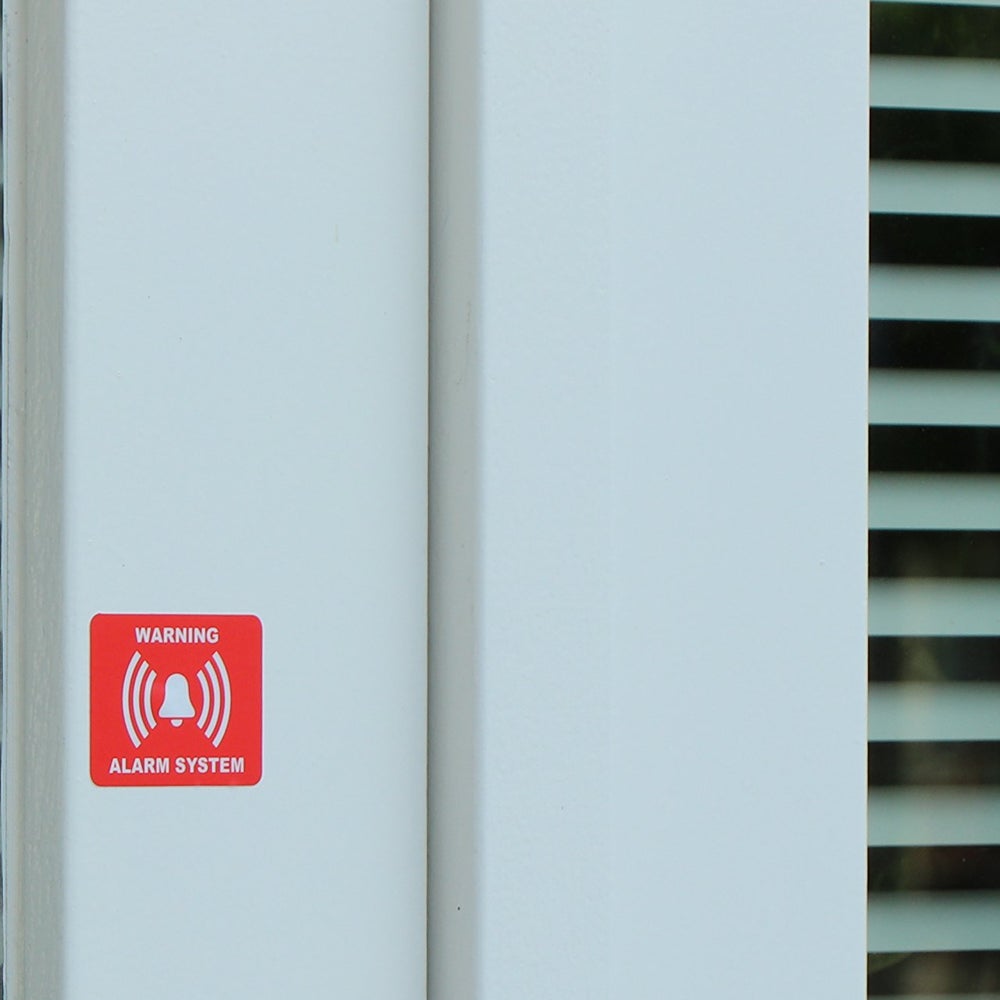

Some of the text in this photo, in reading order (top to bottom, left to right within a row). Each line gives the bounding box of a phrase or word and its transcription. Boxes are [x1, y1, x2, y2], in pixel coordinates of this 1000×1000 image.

[135, 627, 219, 644] WARNING
[109, 757, 245, 774] ALARM SYSTEM
